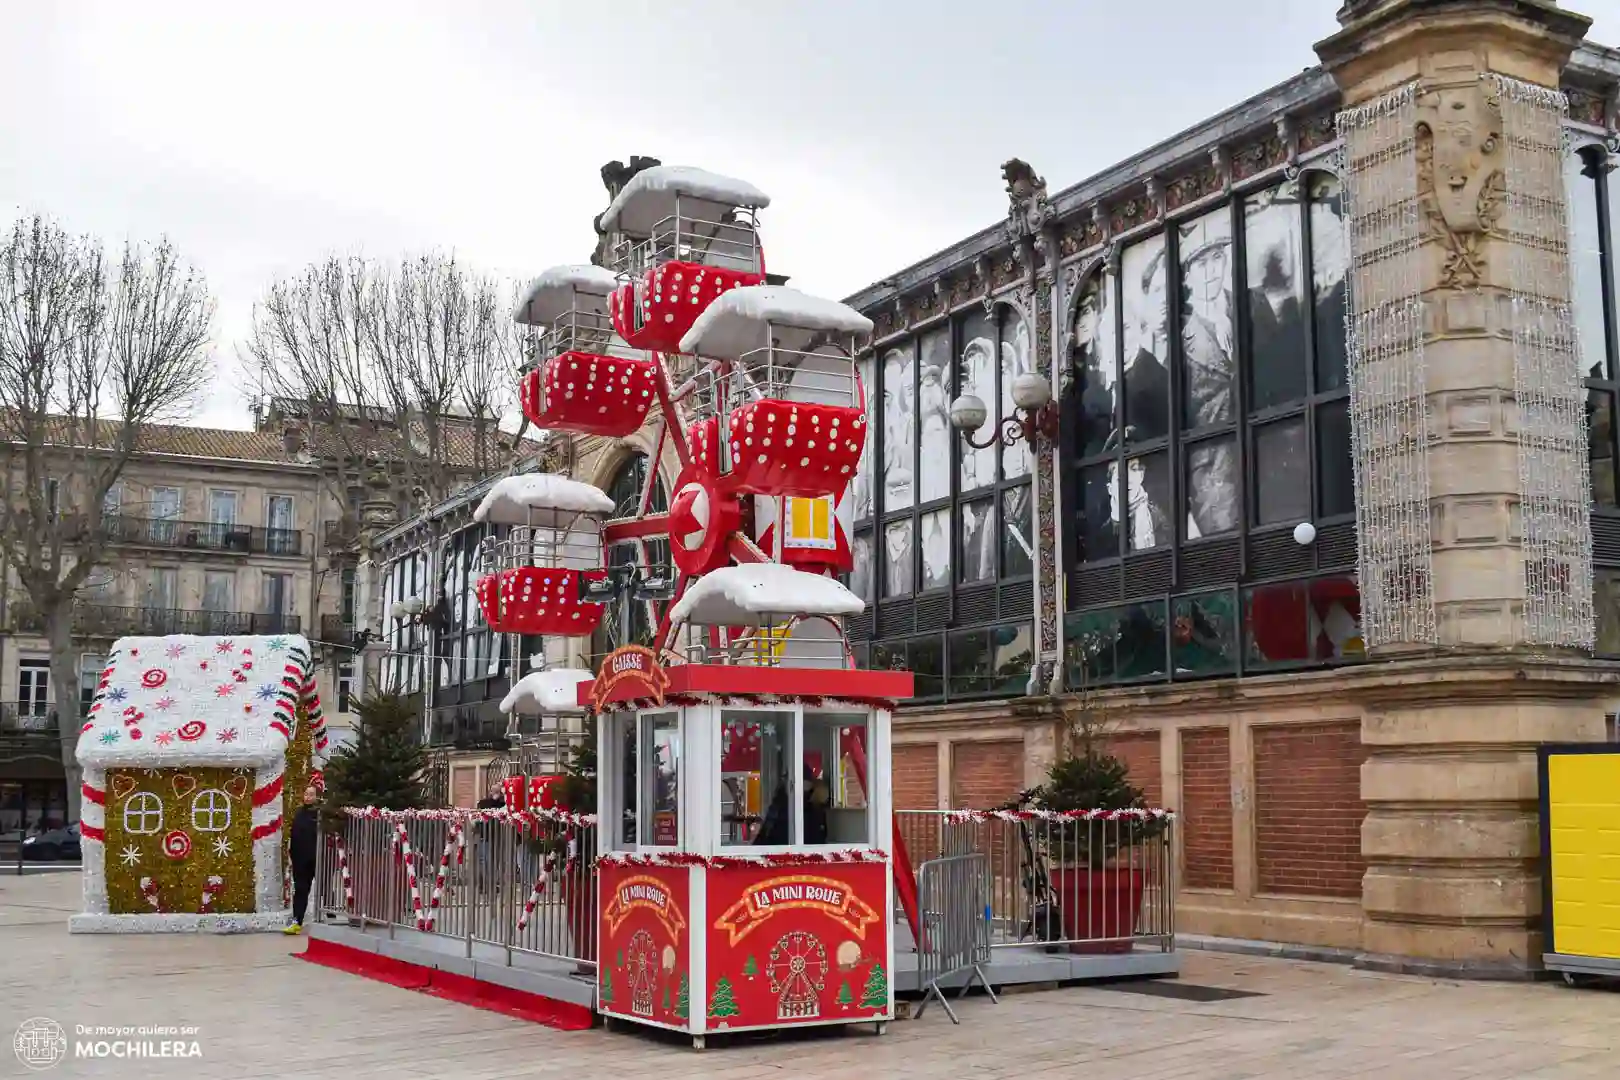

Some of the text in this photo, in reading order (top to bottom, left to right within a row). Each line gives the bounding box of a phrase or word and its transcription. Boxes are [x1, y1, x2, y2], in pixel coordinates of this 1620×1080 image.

[612, 652, 642, 673] CAISSE
[621, 885, 666, 907] LA MINI ROUE
[754, 885, 842, 908] LA MINI ROUE
